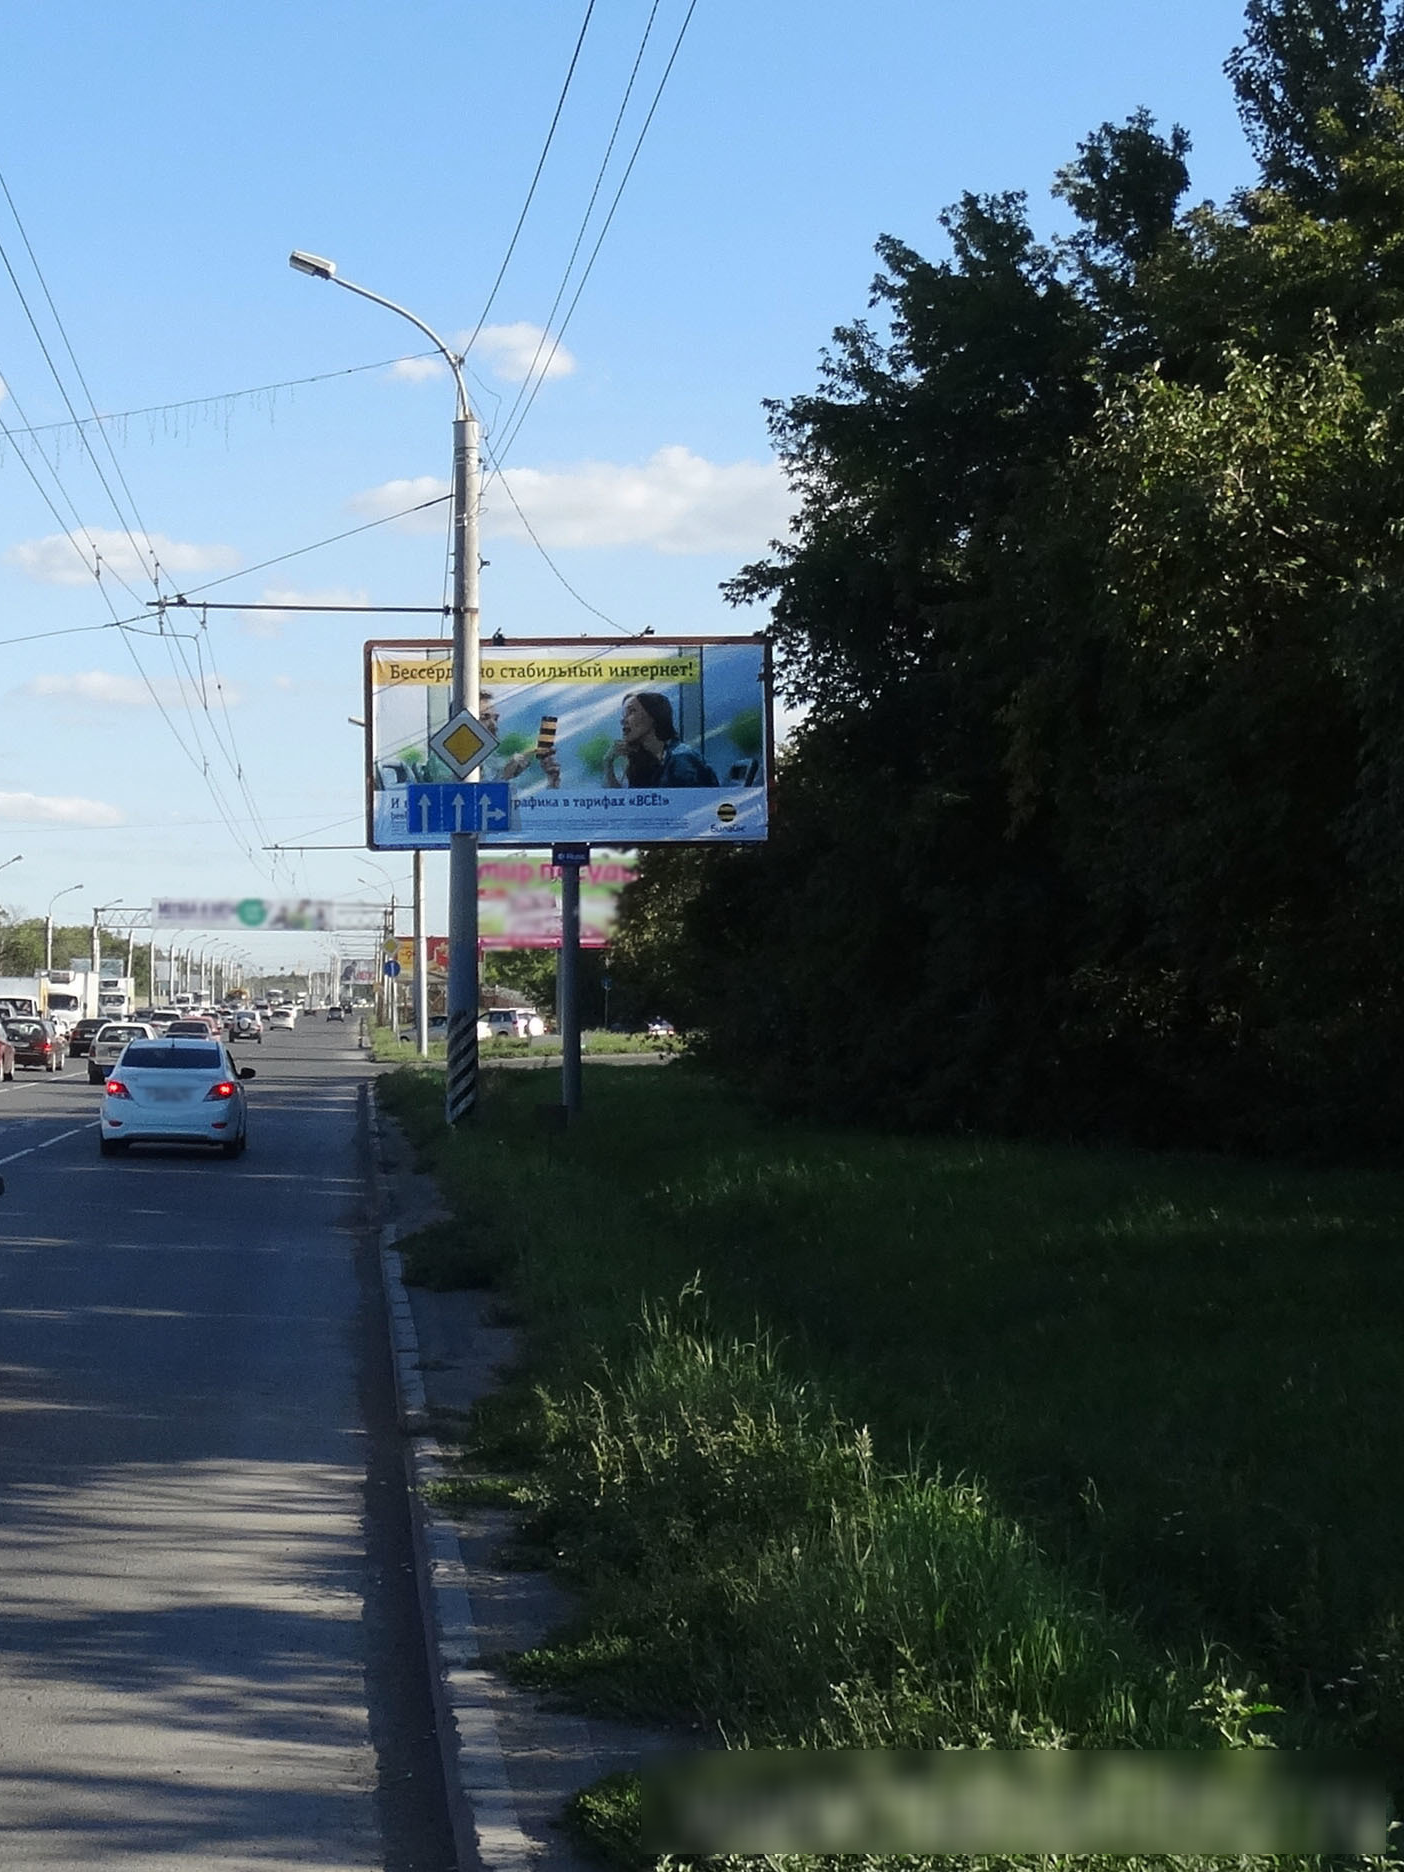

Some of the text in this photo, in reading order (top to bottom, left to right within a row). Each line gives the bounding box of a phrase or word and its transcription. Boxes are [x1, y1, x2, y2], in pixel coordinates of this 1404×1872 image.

[500, 662, 603, 678] стабильный
[609, 662, 693, 680] интернет!
[512, 796, 558, 810] рафика
[563, 799, 570, 807] в
[573, 795, 625, 809] тарифах
